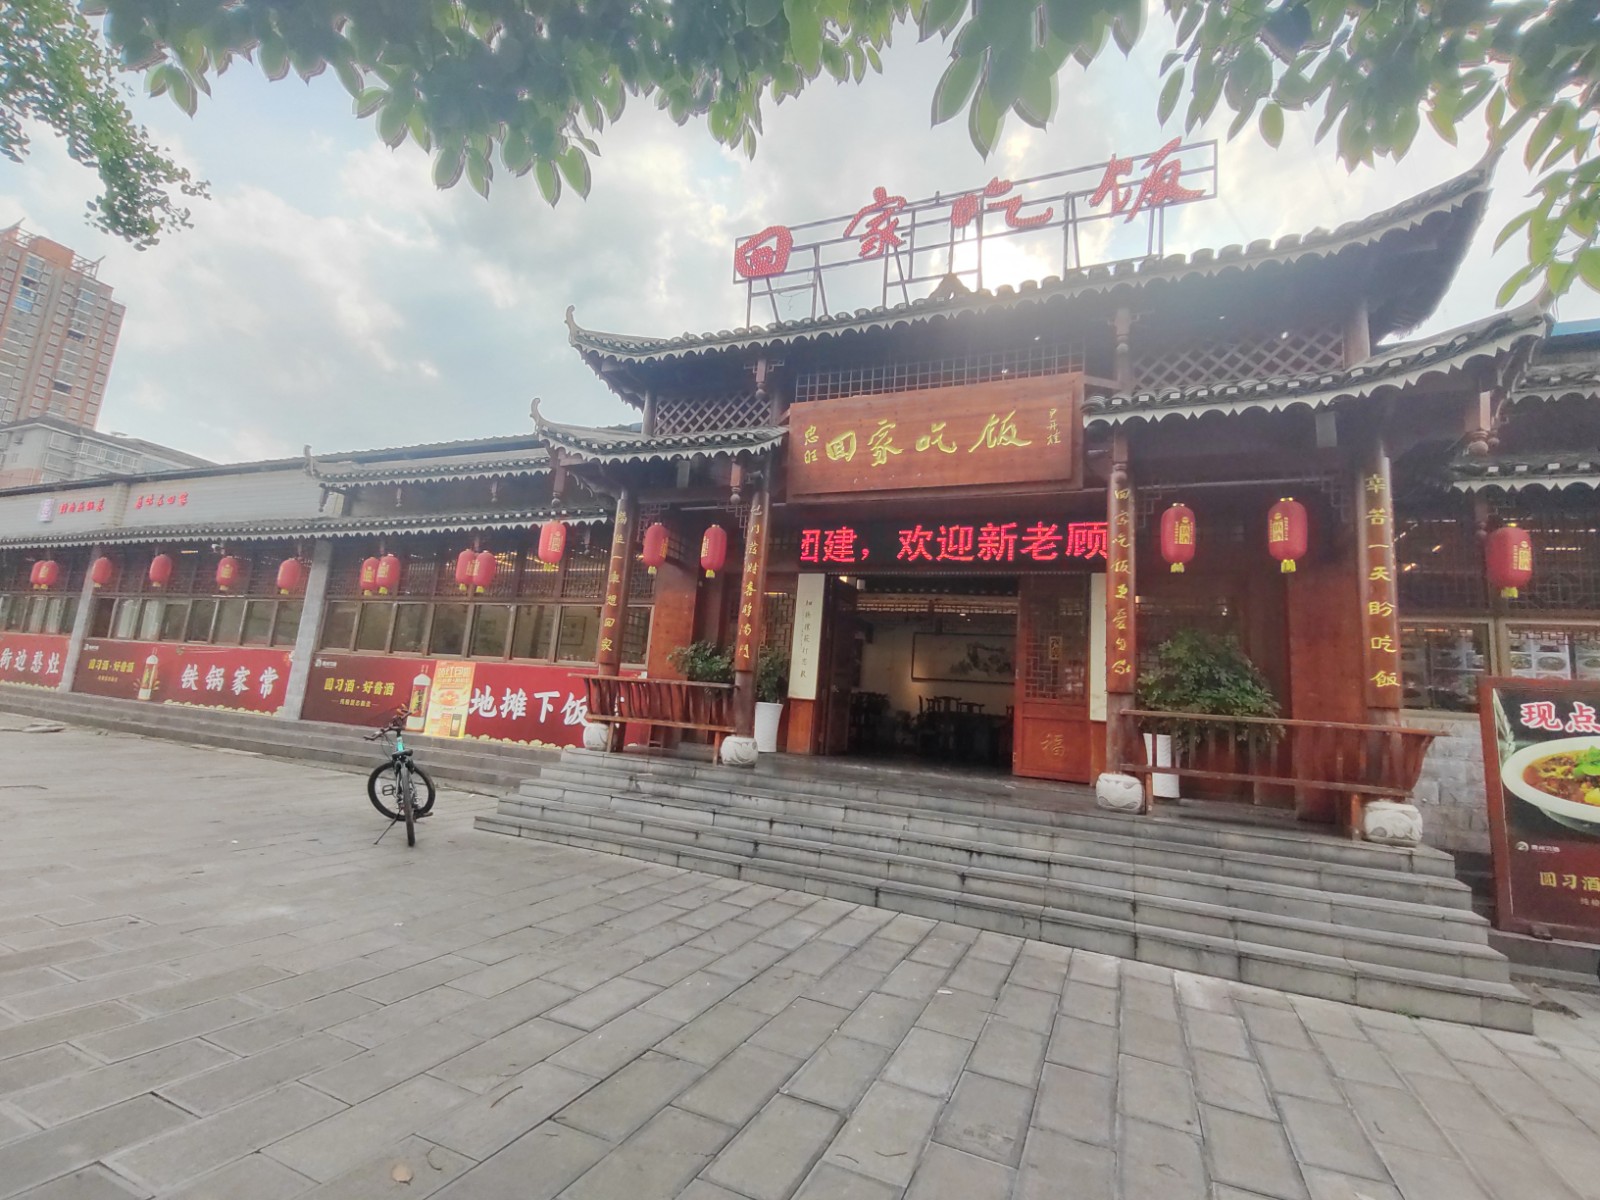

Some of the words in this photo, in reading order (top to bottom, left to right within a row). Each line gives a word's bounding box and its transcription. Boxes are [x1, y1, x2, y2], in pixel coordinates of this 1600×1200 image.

[733, 136, 1205, 278] 回家吃饭
[825, 409, 1033, 467] 回家吃饭
[181, 663, 279, 699] 铁锅家常
[469, 684, 625, 728] 地摊下饭
[1520, 701, 1600, 733] 现点
[1540, 871, 1600, 892] 圆习酒
